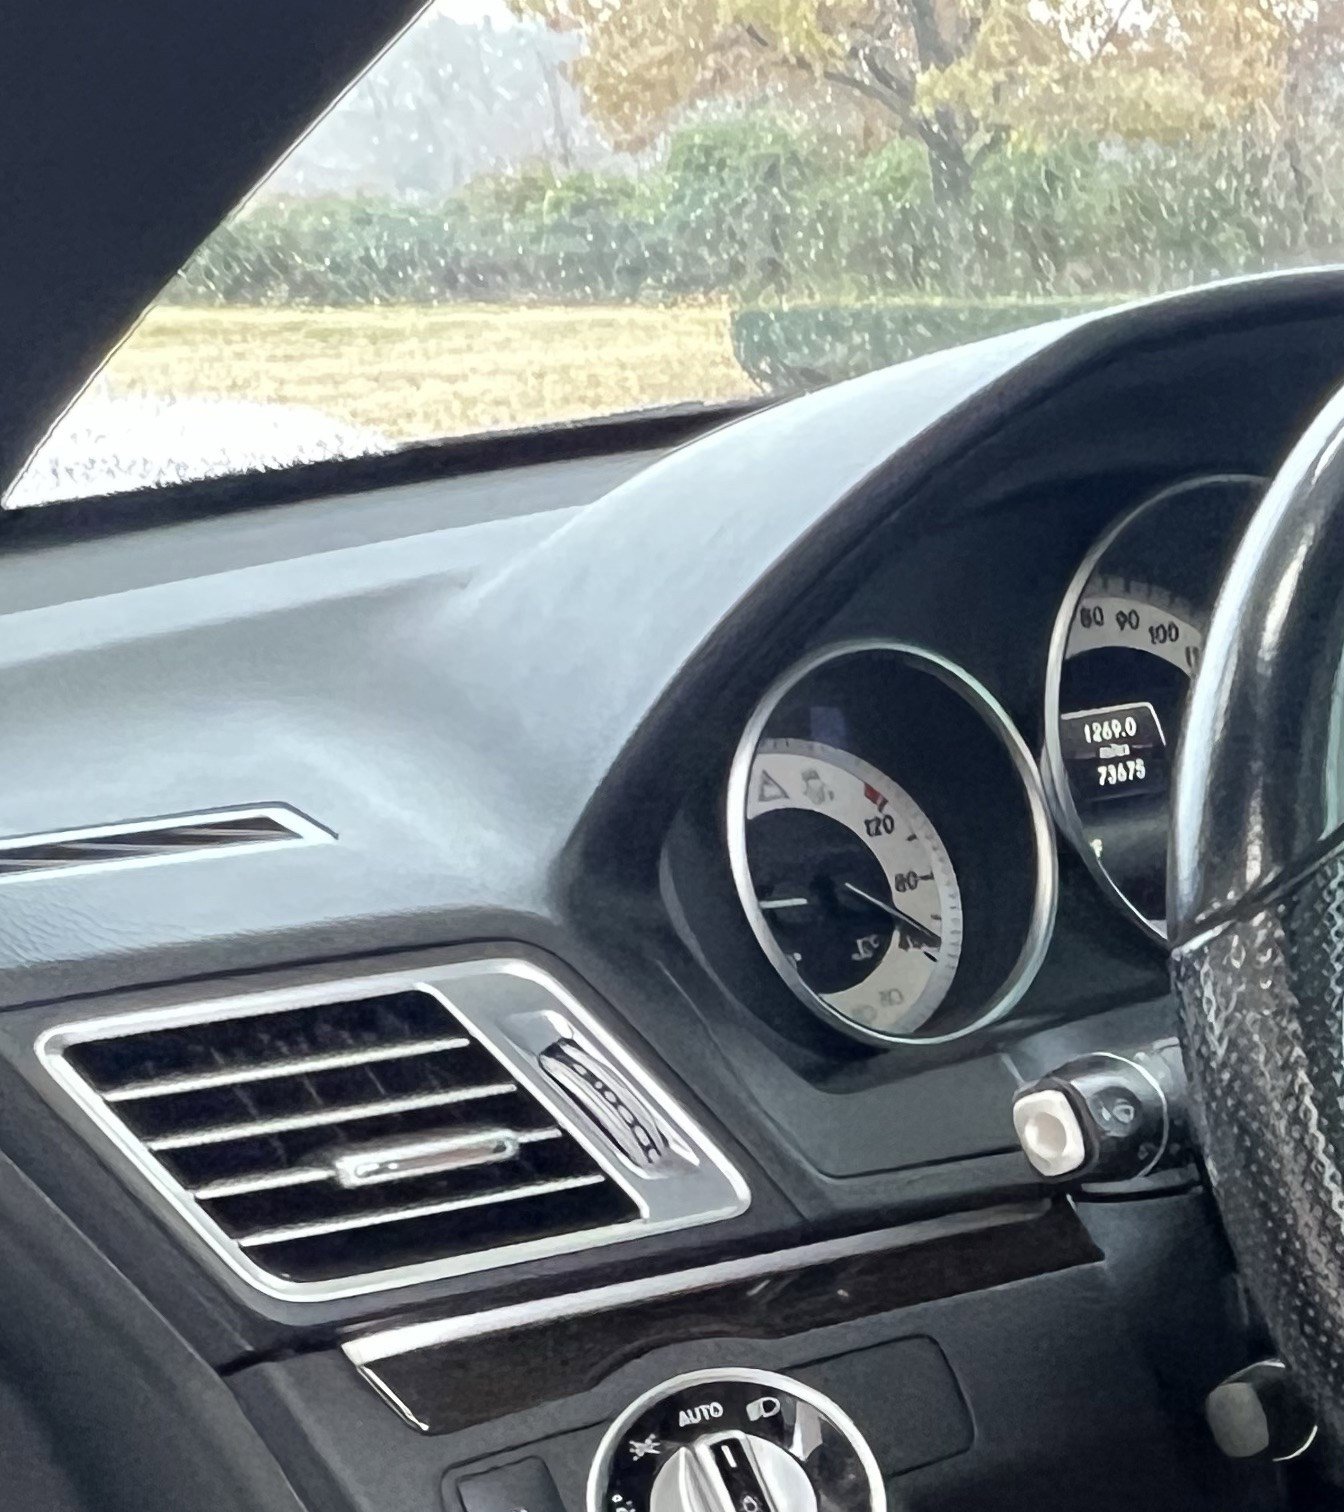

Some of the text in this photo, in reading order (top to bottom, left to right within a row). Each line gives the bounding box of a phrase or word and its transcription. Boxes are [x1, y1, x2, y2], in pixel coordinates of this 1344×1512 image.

[1115, 609, 1140, 631] 90
[1148, 621, 1179, 645] 100
[678, 1401, 724, 1427] AUTO
